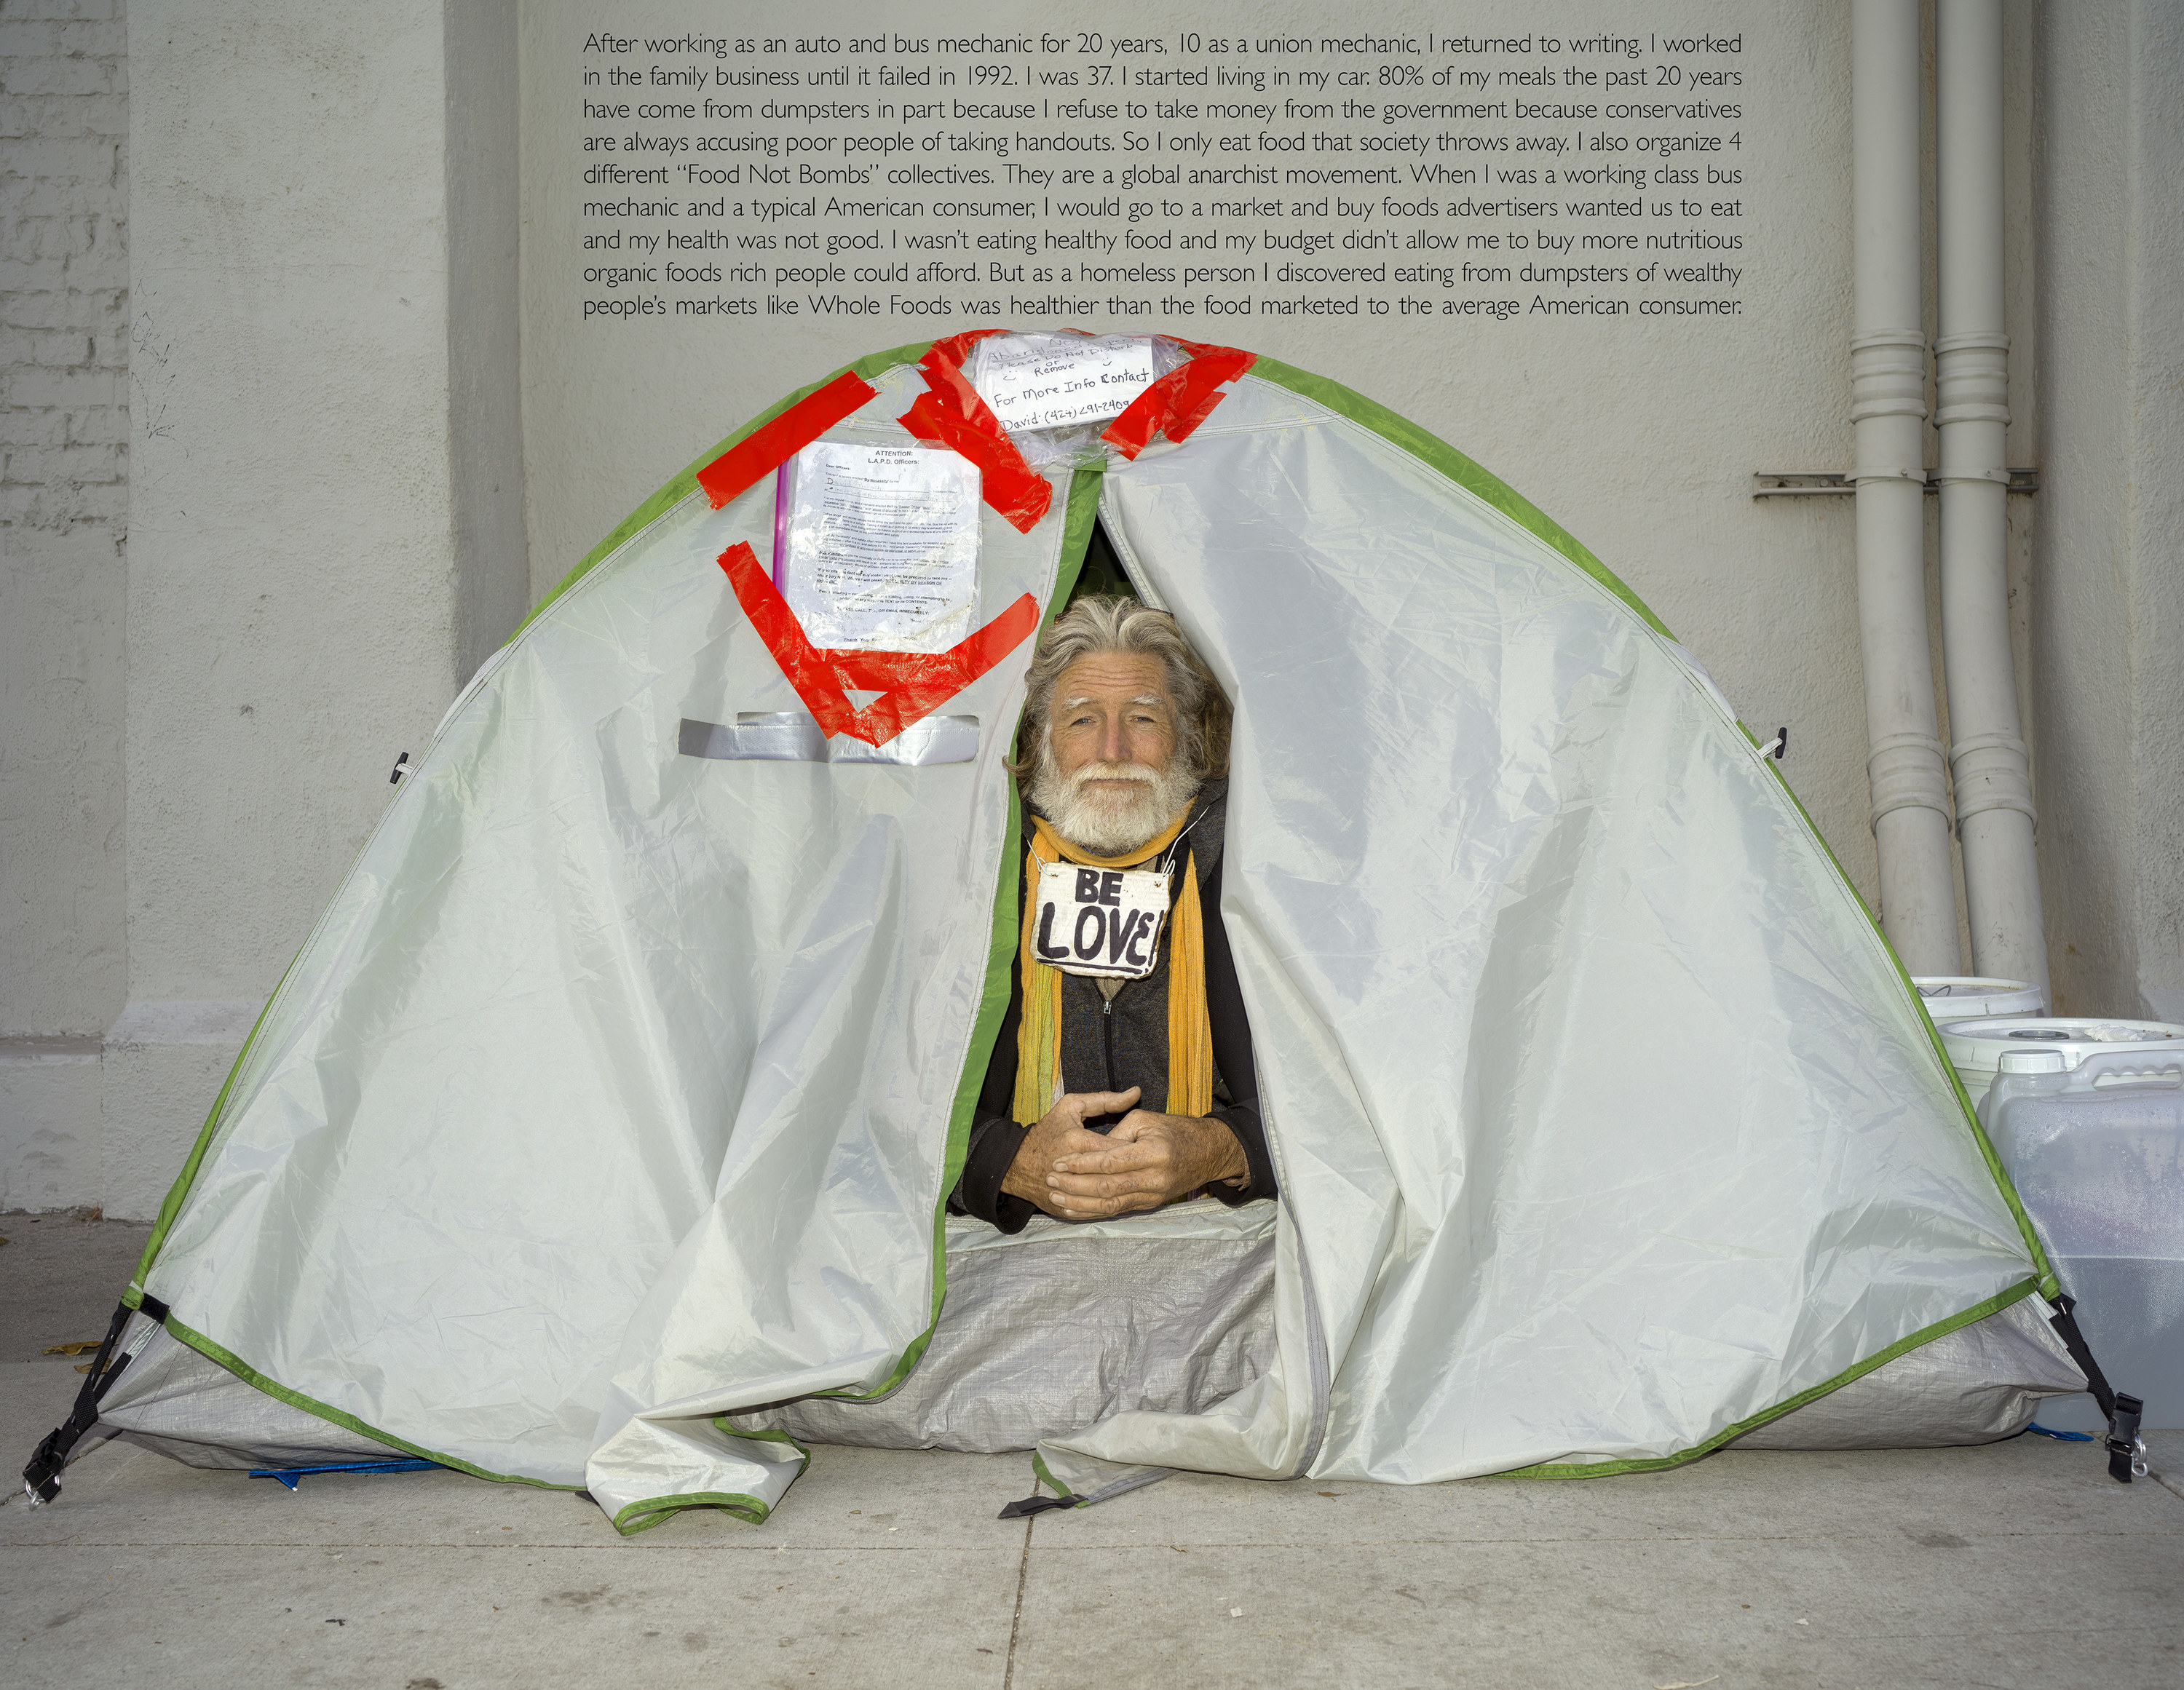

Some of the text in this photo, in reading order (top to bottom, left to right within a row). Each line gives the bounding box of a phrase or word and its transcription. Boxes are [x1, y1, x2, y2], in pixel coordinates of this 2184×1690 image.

[999, 358, 1041, 370] Please
[1066, 349, 1084, 357] Not
[1089, 344, 1133, 354] Disturb
[1034, 362, 1075, 377] Remove
[1045, 360, 1060, 368] or
[994, 394, 1017, 408] For
[1064, 378, 1096, 393] Info
[1100, 368, 1150, 384] Contact
[1075, 868, 1124, 907] BE
